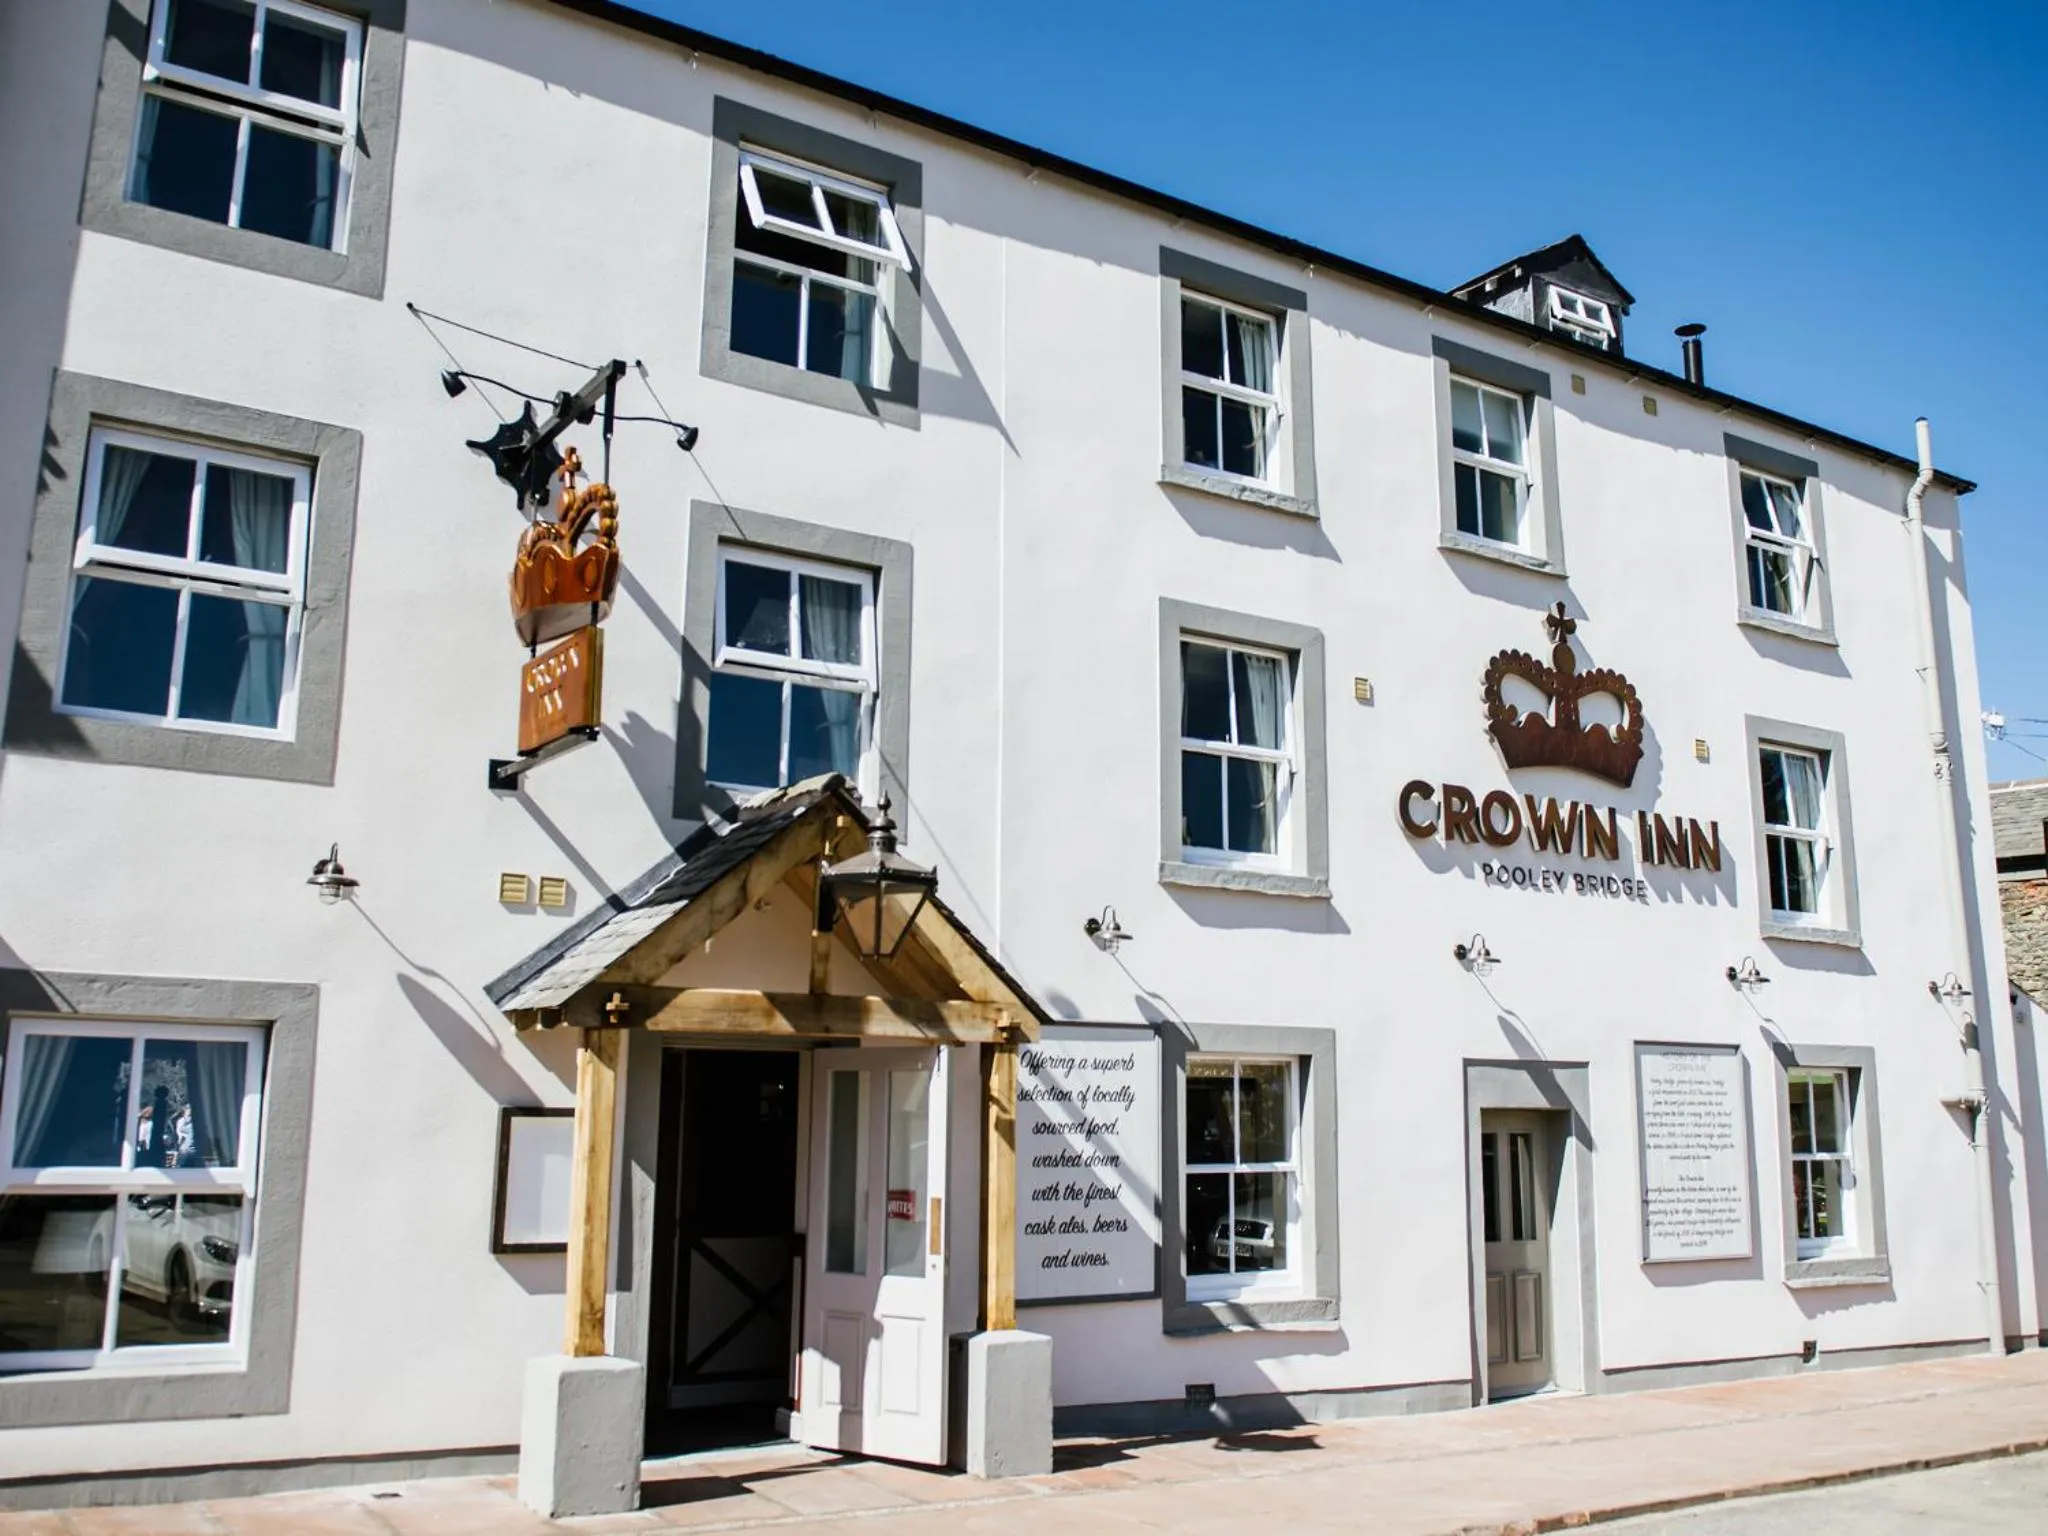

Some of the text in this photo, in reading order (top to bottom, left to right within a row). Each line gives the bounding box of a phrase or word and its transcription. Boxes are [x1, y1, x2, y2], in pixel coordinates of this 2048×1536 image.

[1398, 778, 1722, 873] CROWN INN
[1482, 862, 1650, 902] POOLEY BRIDGE
[1020, 1049, 1135, 1079] Offering a superb
[1017, 1083, 1135, 1112] selection of locally
[1032, 1116, 1087, 1136] sourced
[1032, 1148, 1120, 1168] washed down
[1032, 1182, 1060, 1201] with
[1063, 1181, 1083, 1201] the
[1025, 1215, 1056, 1235] cask
[1092, 1213, 1128, 1233] beers
[1041, 1248, 1071, 1269] and
